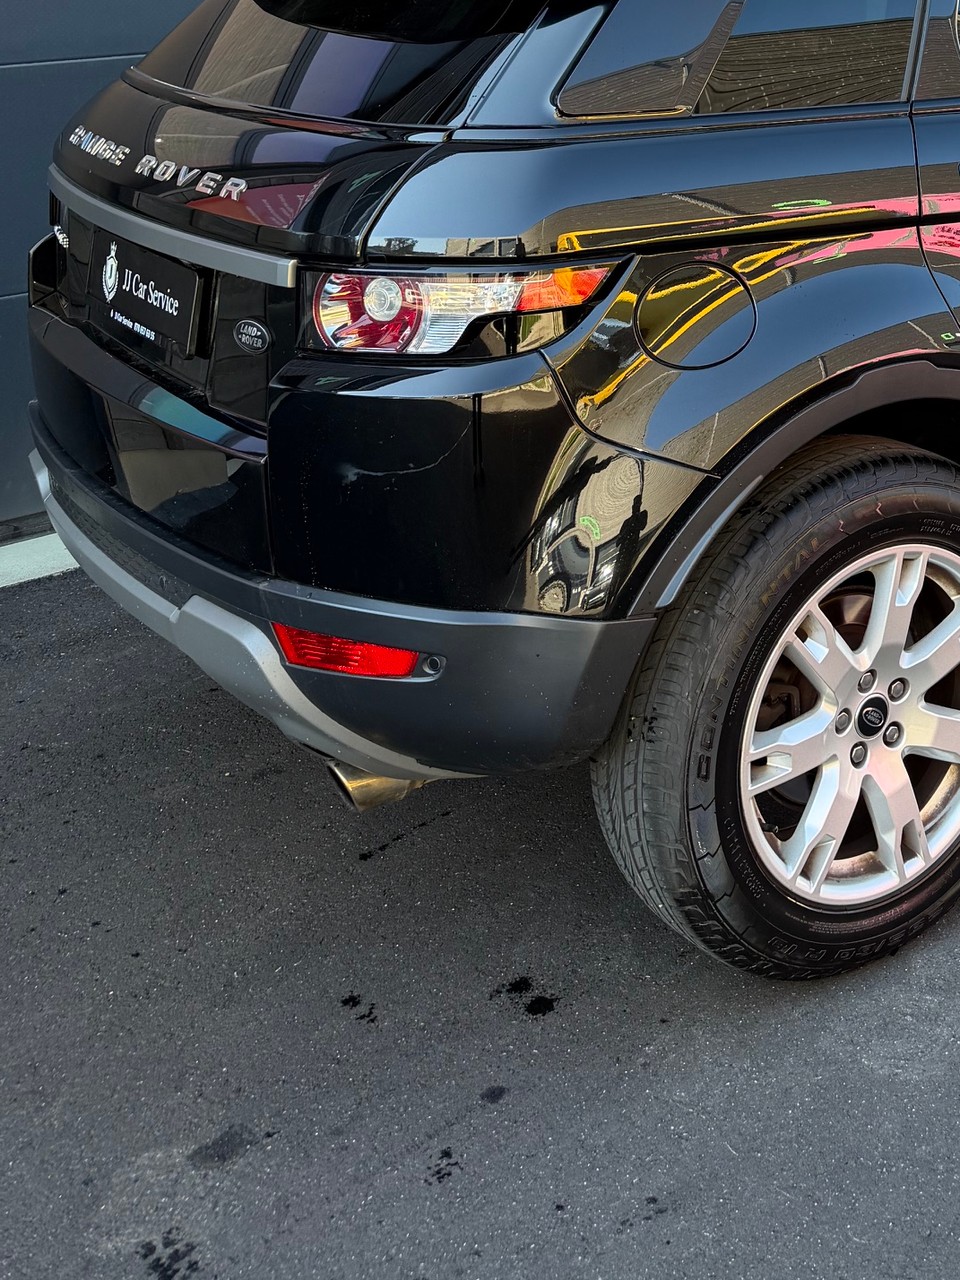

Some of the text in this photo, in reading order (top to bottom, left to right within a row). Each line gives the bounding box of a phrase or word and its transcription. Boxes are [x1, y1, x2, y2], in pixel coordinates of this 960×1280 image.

[69, 124, 249, 202] RANGE ROVER
[122, 268, 179, 316] JJ Car Service
[240, 323, 258, 337] LAND
[241, 333, 263, 349] ROVER
